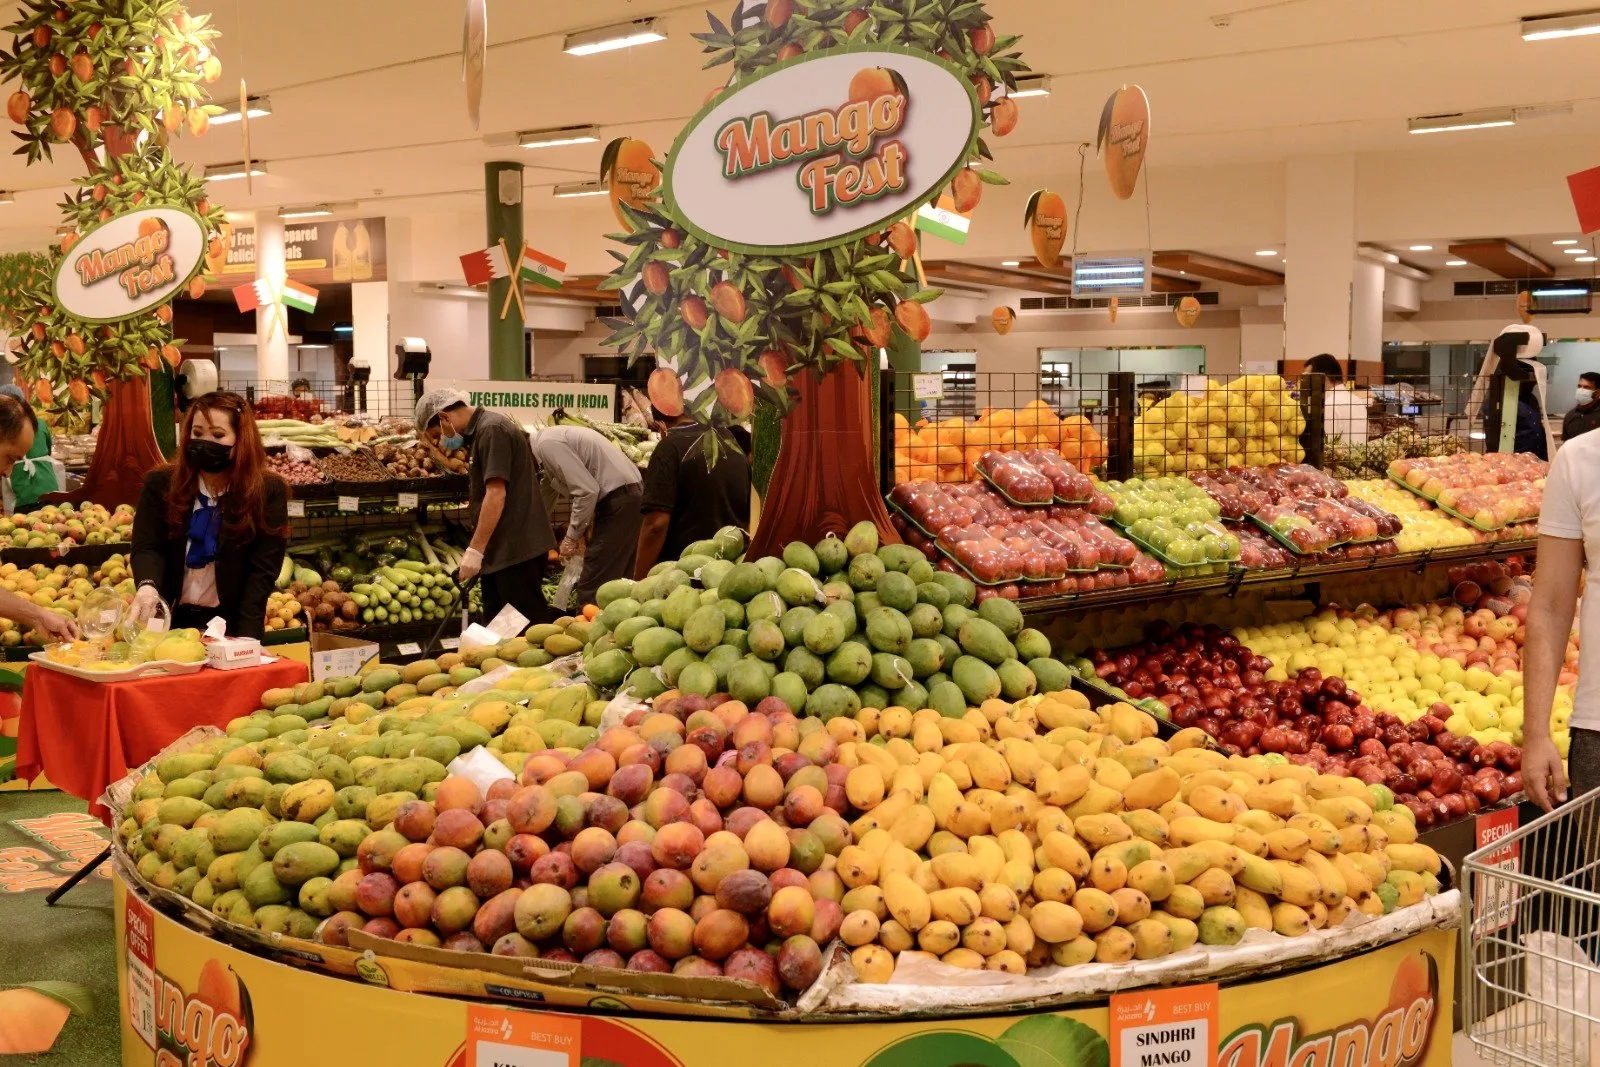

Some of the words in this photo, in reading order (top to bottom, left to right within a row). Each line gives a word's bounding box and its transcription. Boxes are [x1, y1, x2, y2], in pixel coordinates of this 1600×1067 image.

[715, 93, 906, 176] Mango
[800, 142, 906, 212] Fest
[75, 229, 170, 285] Mango
[120, 254, 175, 298] Fest
[470, 391, 540, 408] VEGETABLES
[542, 393, 574, 408] FROM
[577, 394, 609, 409] INDIA
[1481, 822, 1513, 844] SPECIAL
[128, 908, 149, 942] SPECIAL
[130, 933, 148, 960] OFFER
[1173, 1004, 1193, 1015] BEST
[1195, 1002, 1211, 1013] BUY
[531, 1031, 552, 1043] BEST
[554, 1035, 573, 1046] BUY
[1136, 1027, 1196, 1047] SINDHRI
[1141, 1049, 1191, 1067] MANGO
